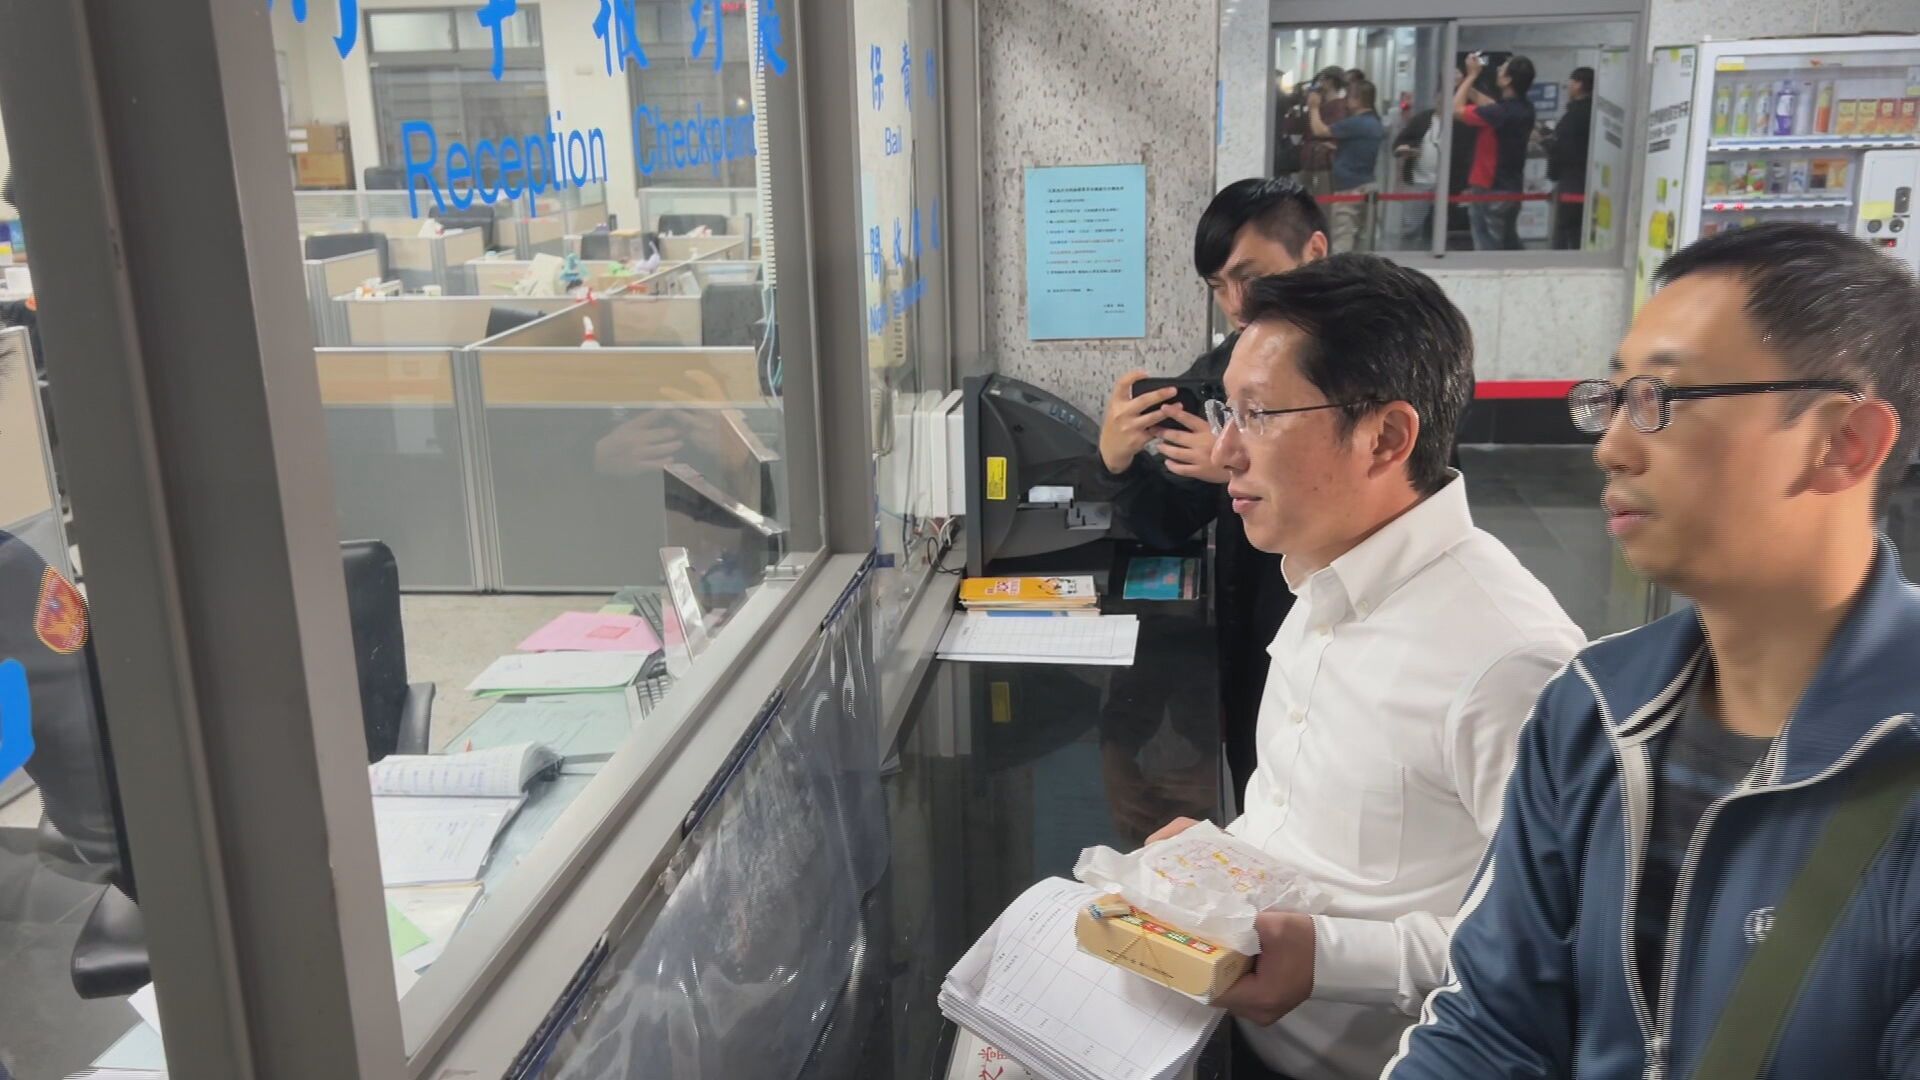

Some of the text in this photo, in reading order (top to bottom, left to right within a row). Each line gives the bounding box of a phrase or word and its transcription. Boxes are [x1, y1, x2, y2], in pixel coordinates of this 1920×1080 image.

[401, 103, 756, 219] Reception Checkpoint
[884, 124, 902, 156] Bail
